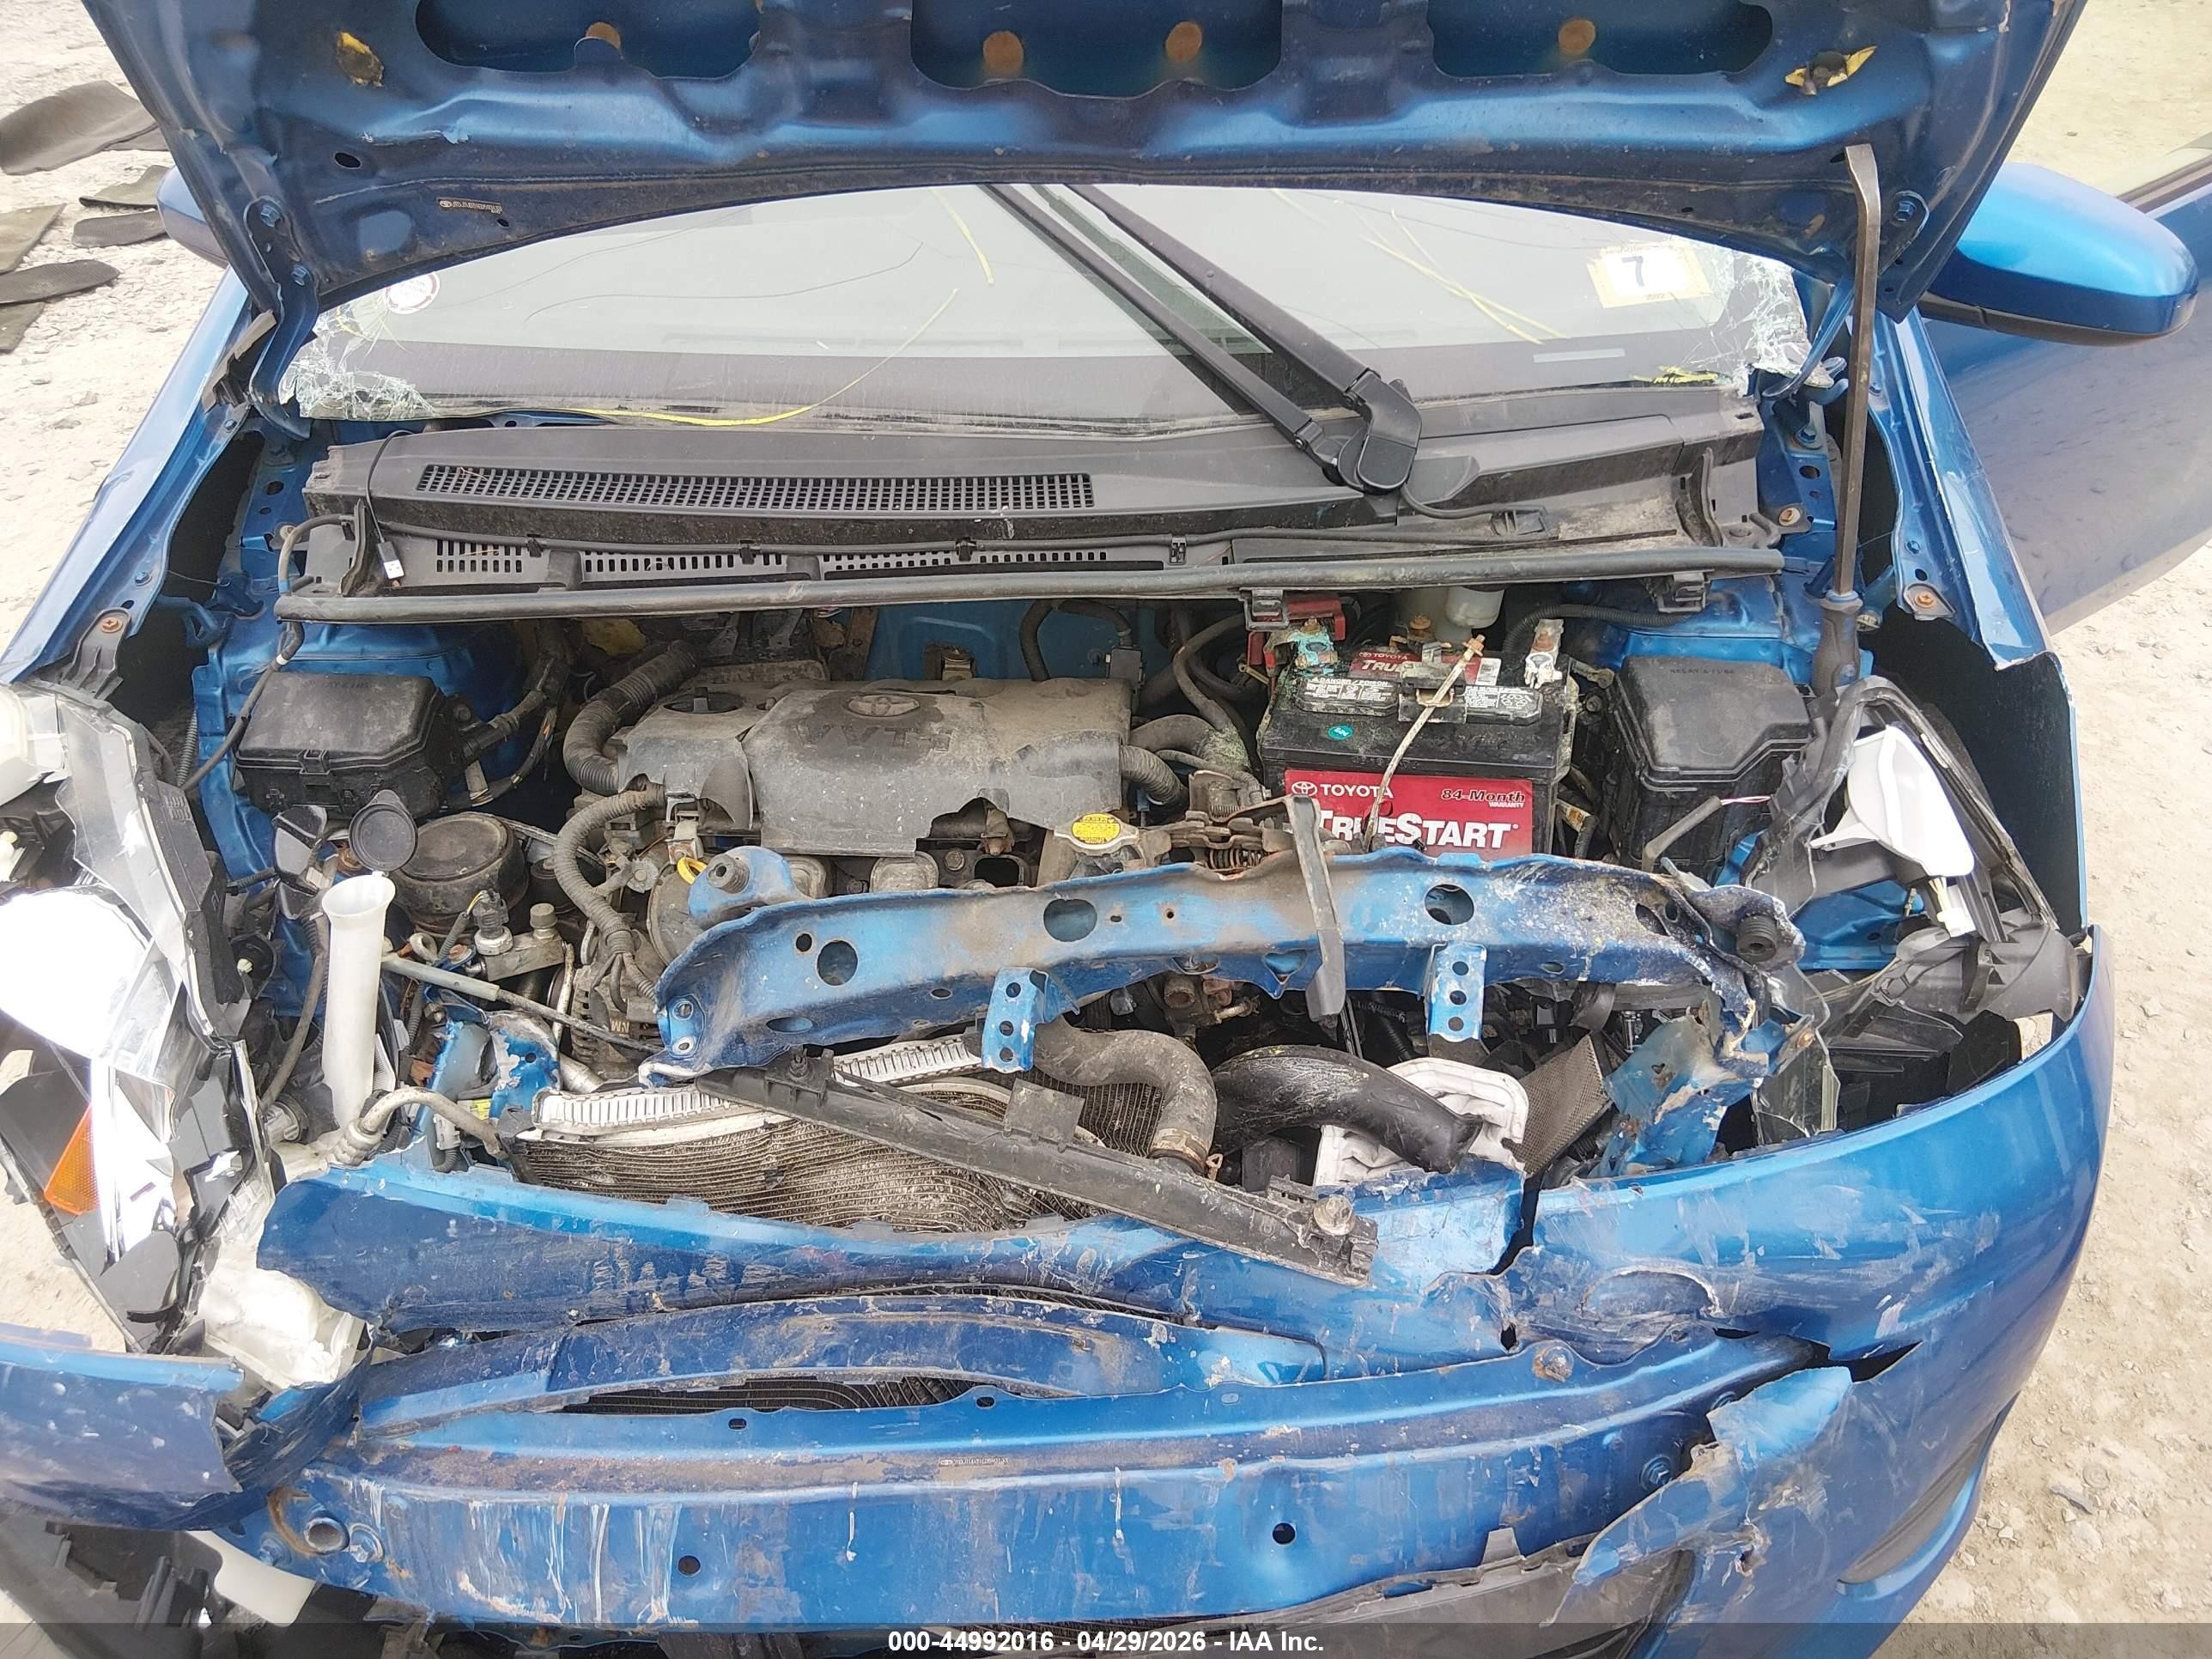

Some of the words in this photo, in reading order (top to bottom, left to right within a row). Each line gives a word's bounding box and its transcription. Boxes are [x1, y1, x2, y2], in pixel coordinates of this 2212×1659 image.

[1621, 255, 1644, 288] 7
[1372, 652, 1408, 660] TOYOTA
[1320, 783, 1394, 799] TOYOTA
[1441, 788, 1525, 803] 84-Month
